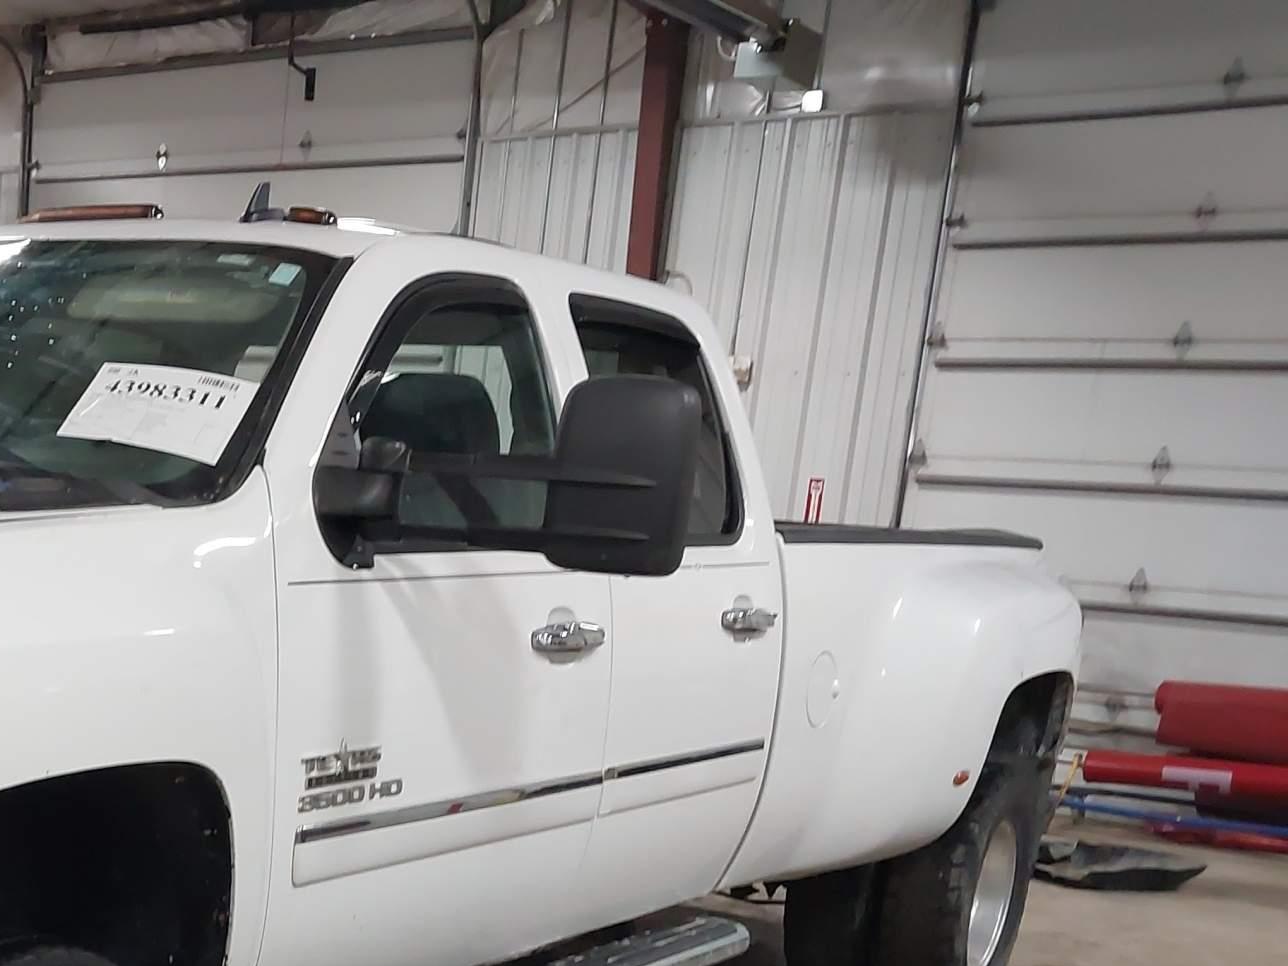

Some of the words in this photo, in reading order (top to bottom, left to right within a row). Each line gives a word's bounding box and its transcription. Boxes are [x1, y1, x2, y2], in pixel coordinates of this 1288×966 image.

[105, 379, 226, 409] 43983311
[298, 785, 365, 813] 3500
[368, 777, 403, 801] HD
